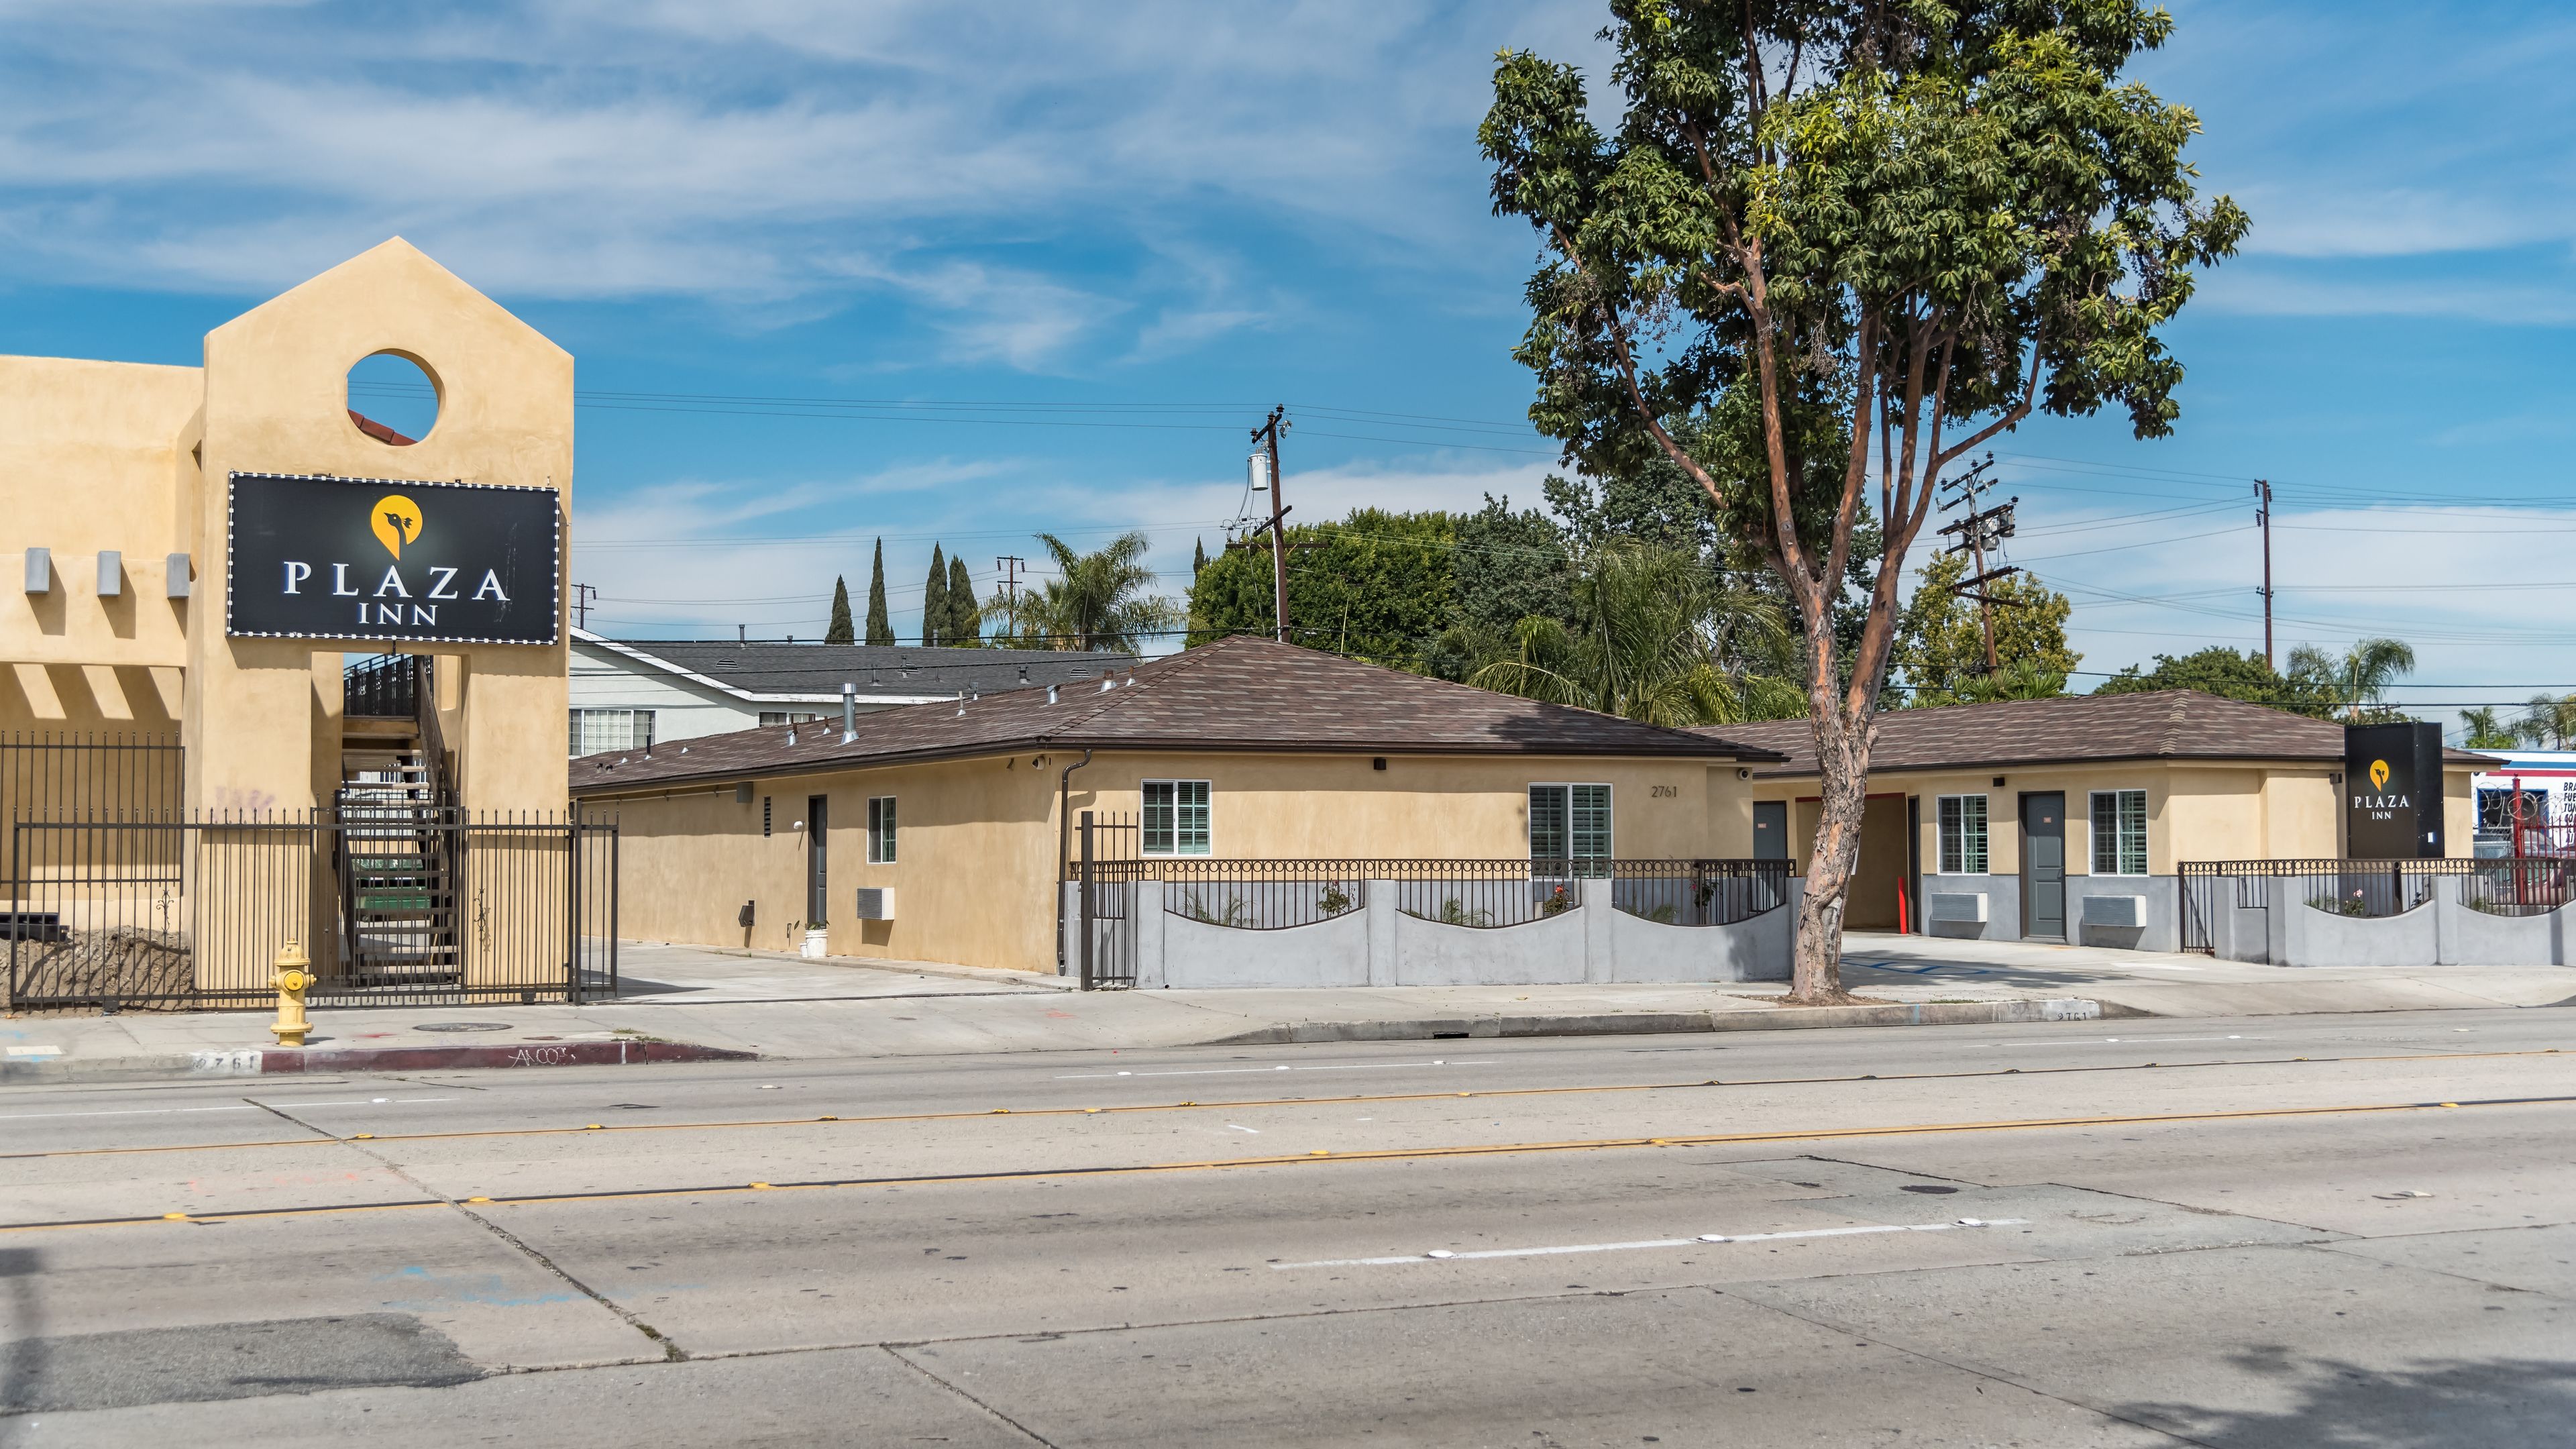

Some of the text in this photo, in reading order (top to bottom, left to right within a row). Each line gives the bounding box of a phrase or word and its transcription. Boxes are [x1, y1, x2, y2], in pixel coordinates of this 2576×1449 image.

[284, 561, 511, 602] PLAZA
[359, 602, 439, 627] INN
[1651, 785, 1677, 798] 2761
[2354, 794, 2410, 809] PLAZA
[2371, 811, 2392, 820] INN
